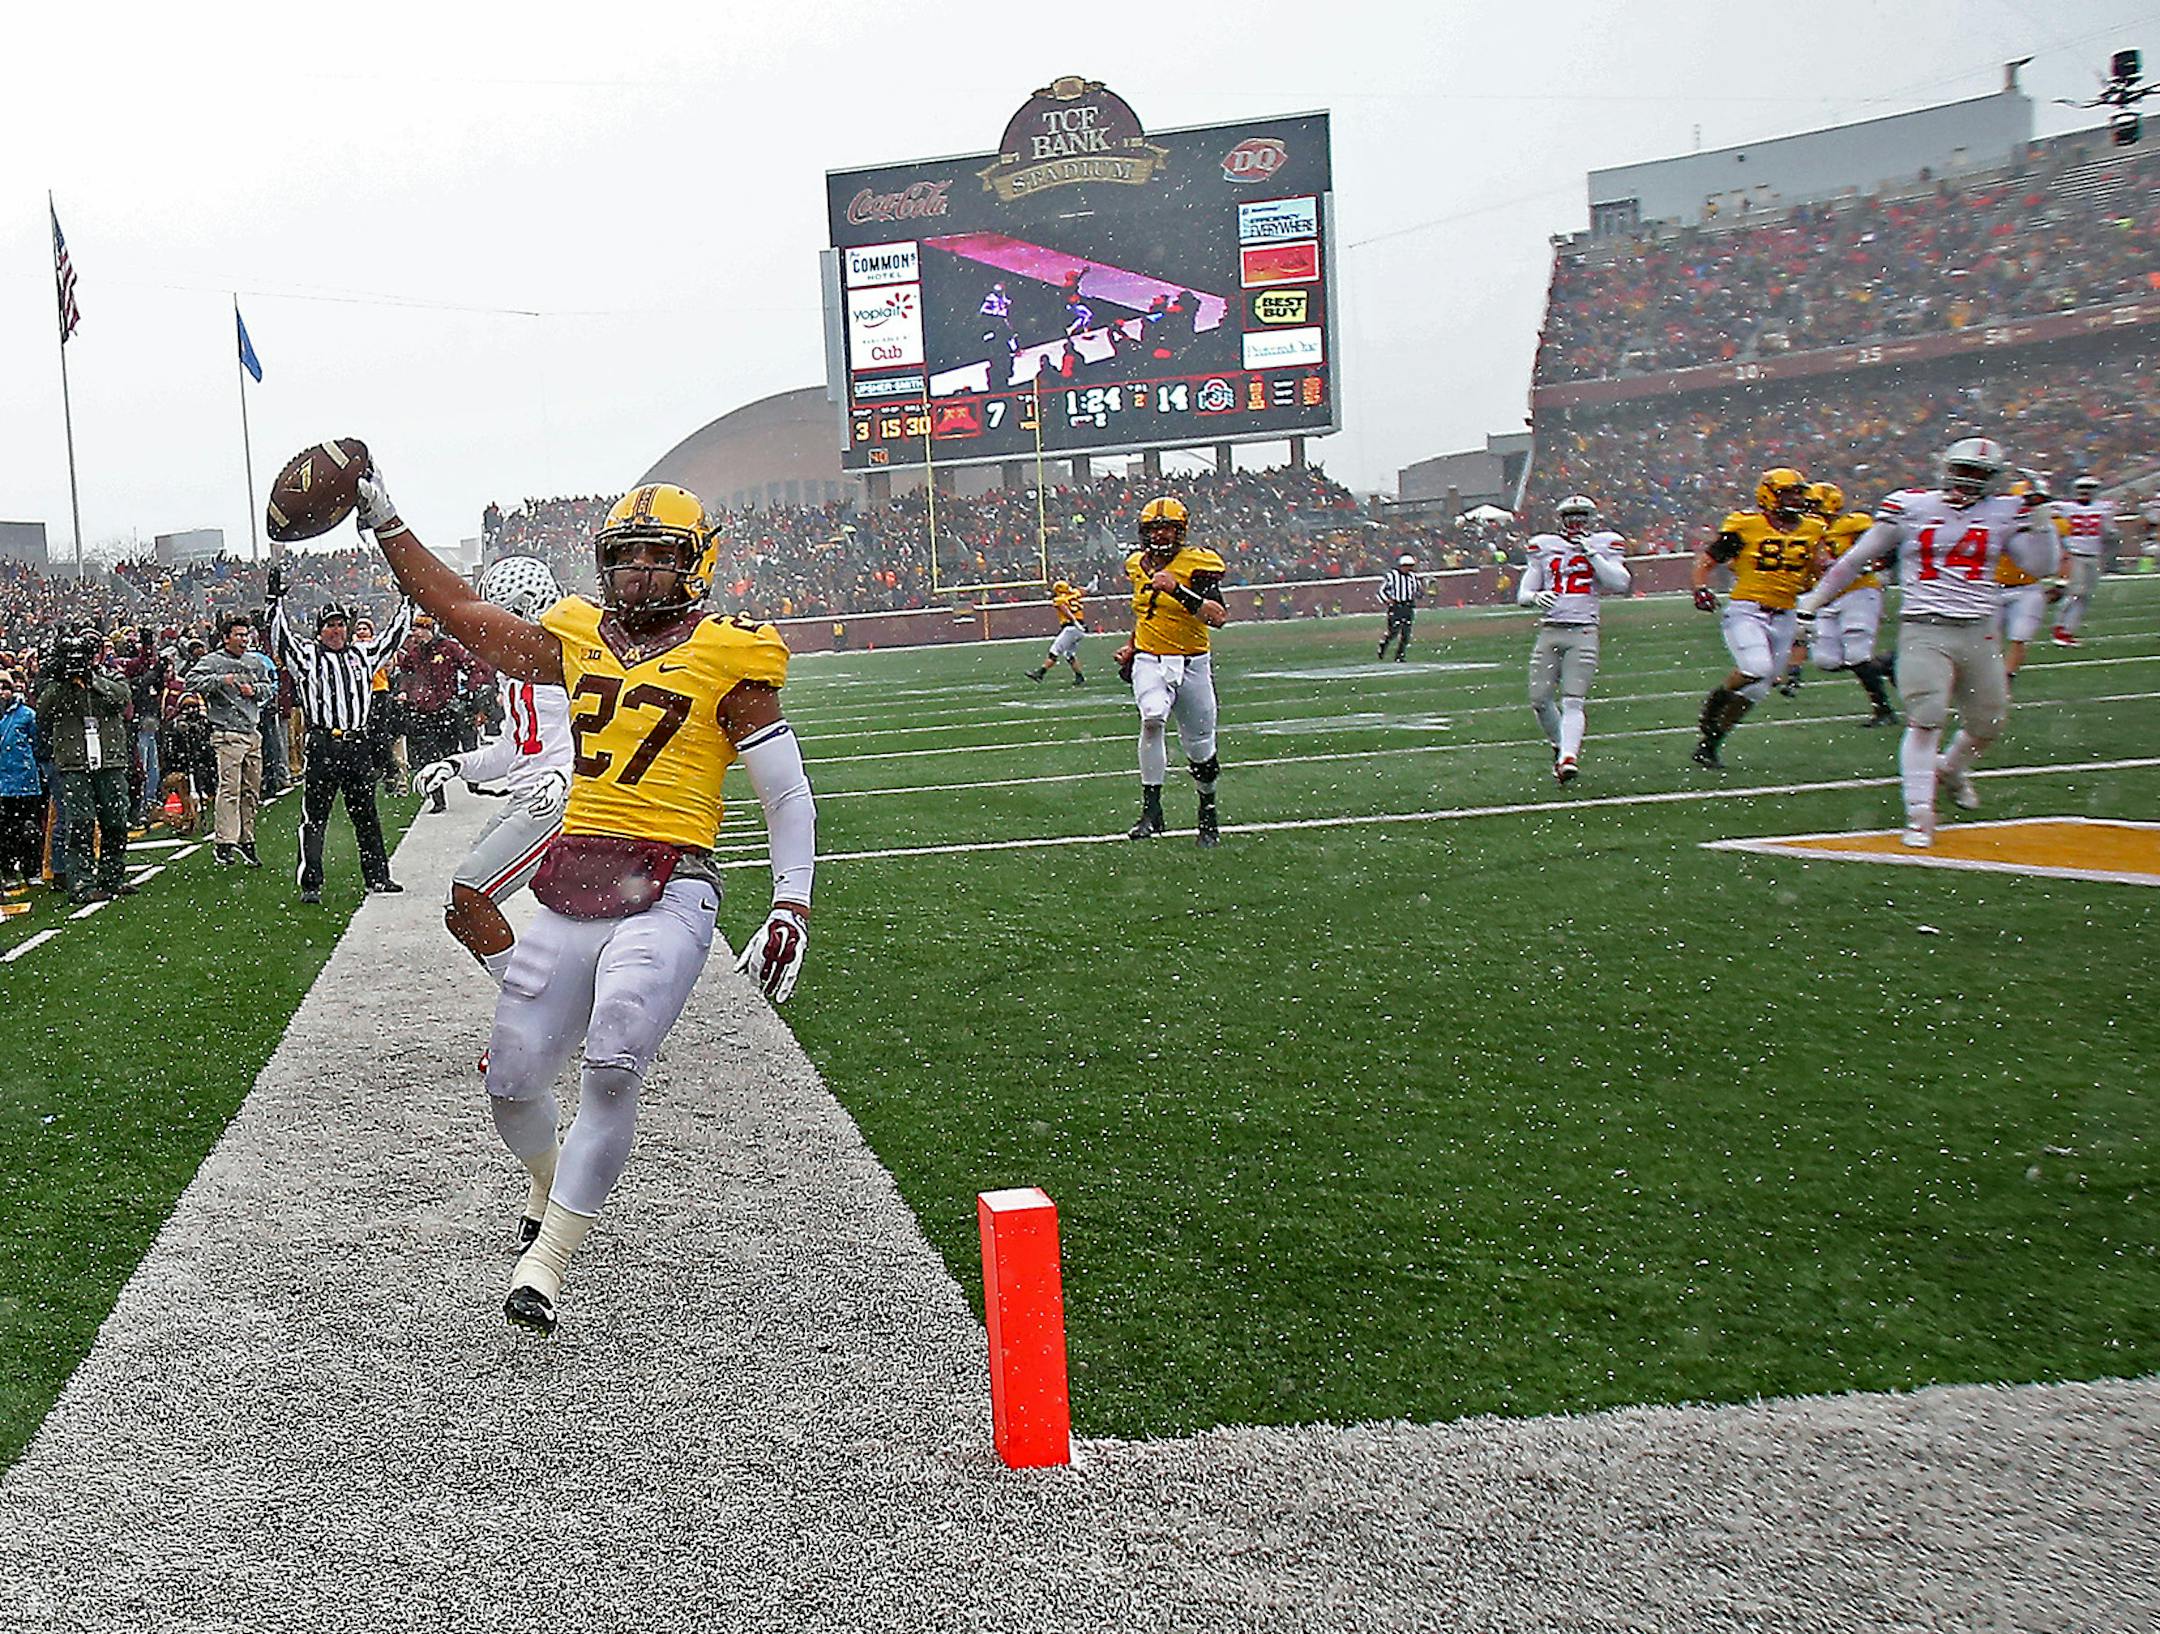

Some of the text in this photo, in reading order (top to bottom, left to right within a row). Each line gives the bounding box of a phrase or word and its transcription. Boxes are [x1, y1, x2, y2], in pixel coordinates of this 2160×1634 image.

[1042, 106, 1099, 135] TCF
[1031, 128, 1113, 161] BANK
[1233, 147, 1277, 171] DQ
[1012, 162, 1134, 194] STADIUM
[847, 180, 954, 226] Coca-Cola
[853, 253, 916, 273] COMMONS
[1263, 297, 1305, 307] BEST
[1263, 308, 1299, 318] BUY
[871, 345, 903, 361] Cub
[855, 422, 870, 441] 3
[881, 418, 902, 439] 15
[905, 415, 931, 437] 30
[987, 401, 1007, 429] 7
[1066, 385, 1122, 414] 1:24
[1157, 384, 1189, 413] 14
[1918, 528, 1989, 580] 14
[1549, 555, 1595, 594] 12
[570, 673, 694, 786] 27
